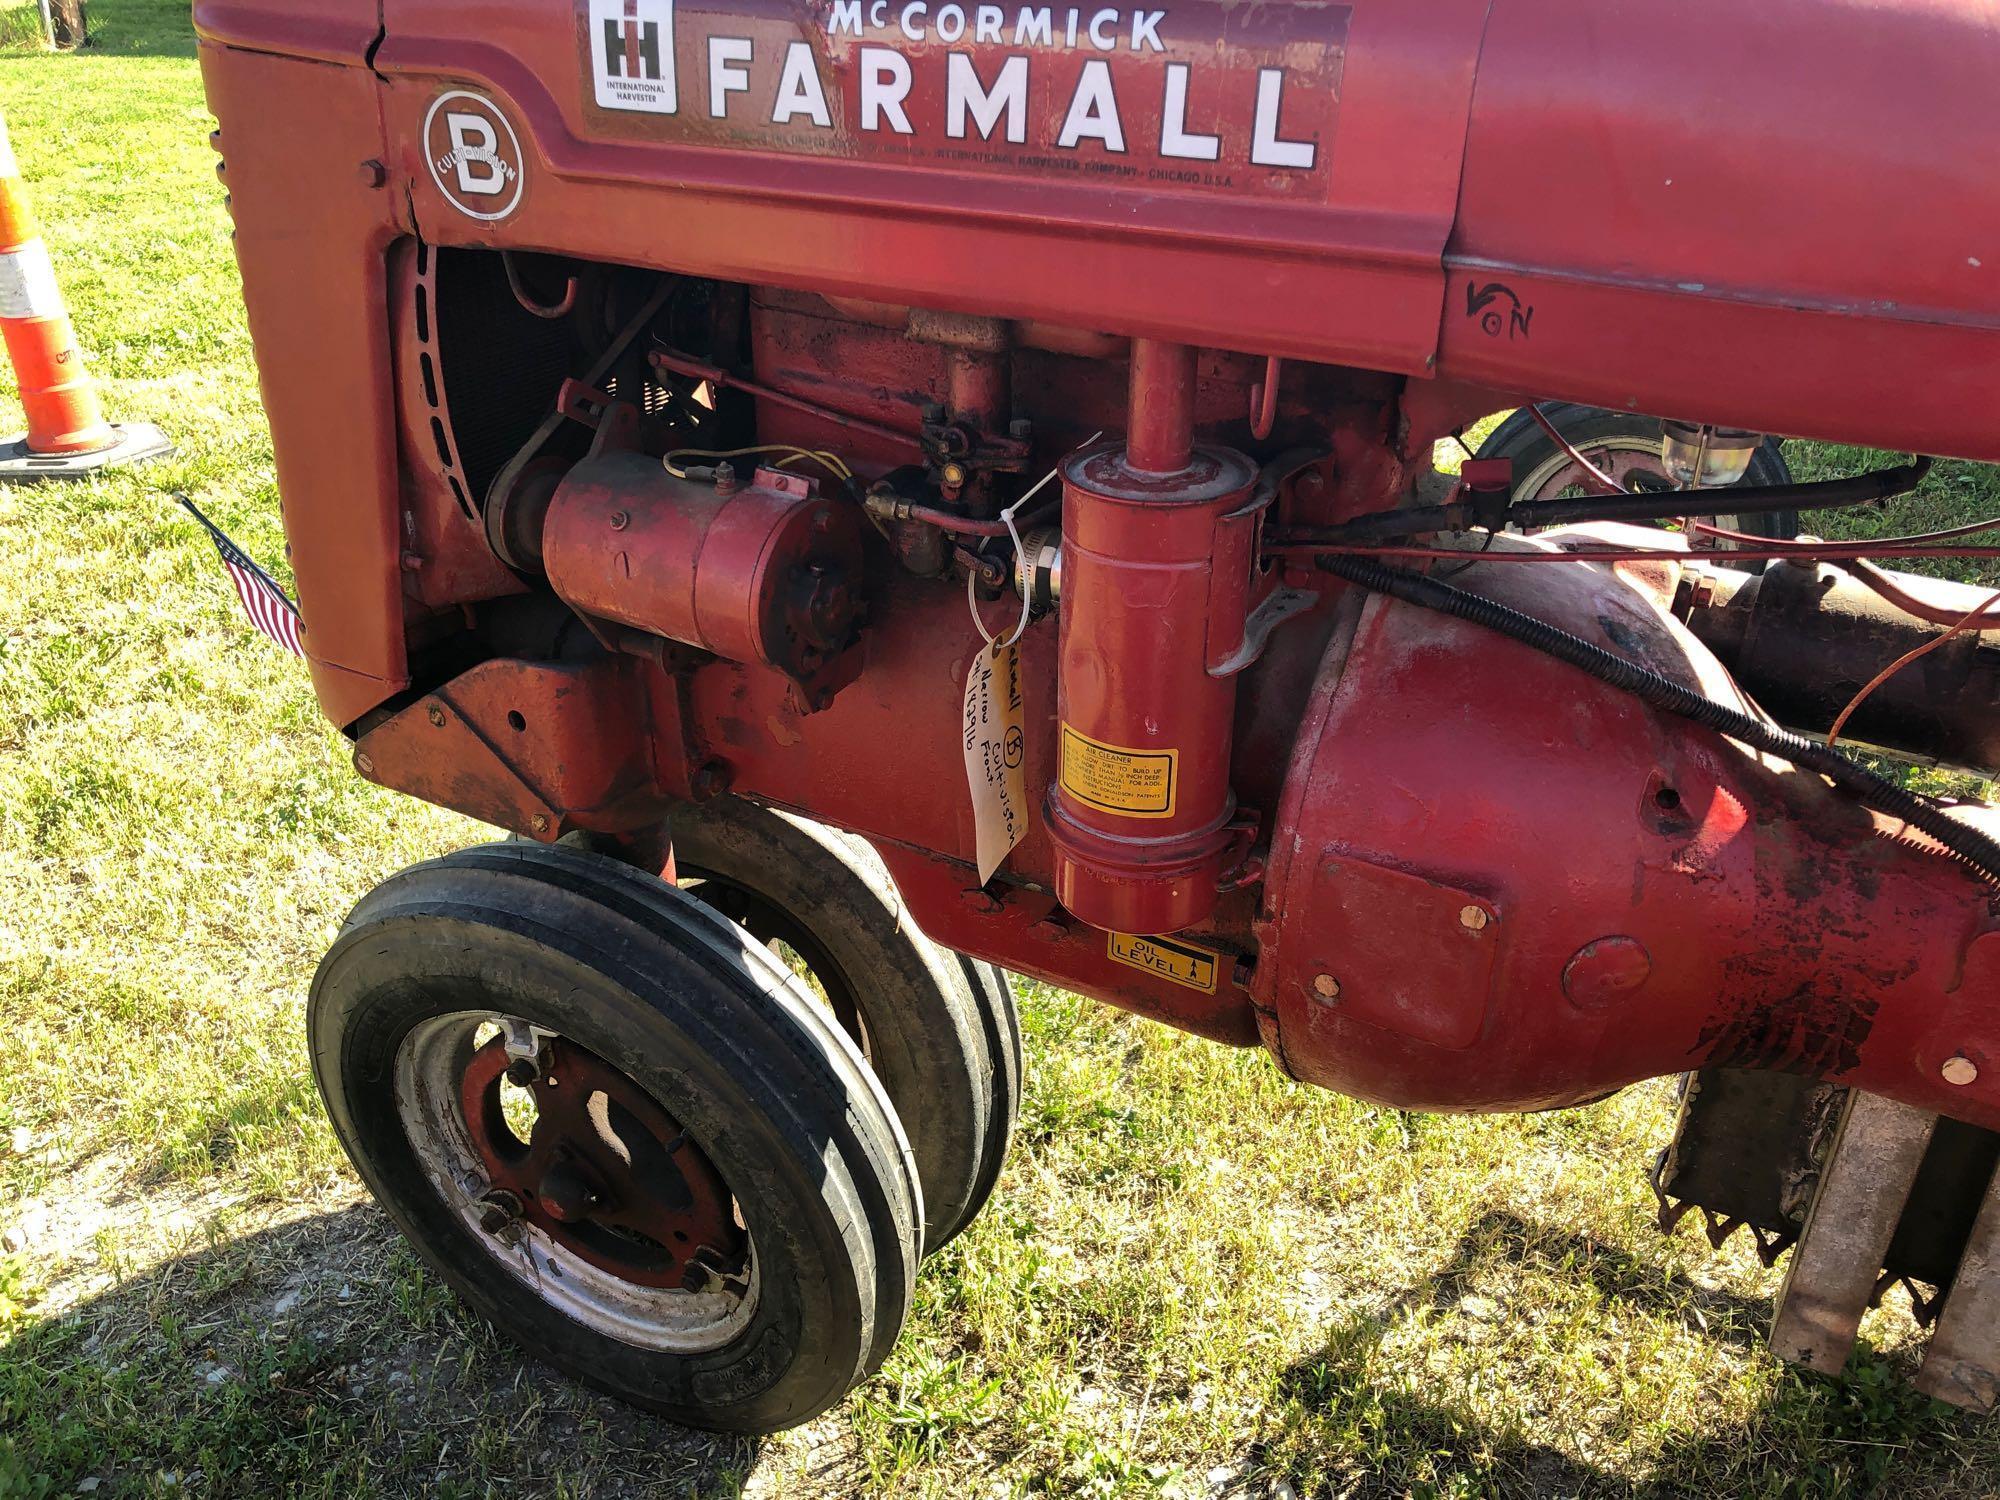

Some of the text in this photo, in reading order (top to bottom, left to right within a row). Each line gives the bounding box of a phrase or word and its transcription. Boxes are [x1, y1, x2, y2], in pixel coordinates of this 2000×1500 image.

[606, 80, 665, 94] INTERNATIONAL
[616, 91, 657, 103] HARVESTER
[707, 34, 1318, 170] FARMALL
[447, 113, 504, 194] B
[1085, 161, 1137, 177] COMPANY
[1149, 170, 1199, 184] CHICAGO
[981, 669, 993, 724] Narrow
[1085, 746, 1132, 764] AIR CLEANER
[1098, 767, 1116, 777] THAN
[1126, 772, 1142, 780] INCH
[1119, 765, 1128, 773] TO
[1133, 767, 1150, 775] BUILD
[1083, 774, 1122, 790] INSTRUCTIONS
[1098, 773, 1125, 785] MANUAL
[1128, 779, 1142, 787] FOR
[1134, 941, 1160, 957] OIL
[1117, 944, 1180, 976] LEVEL
